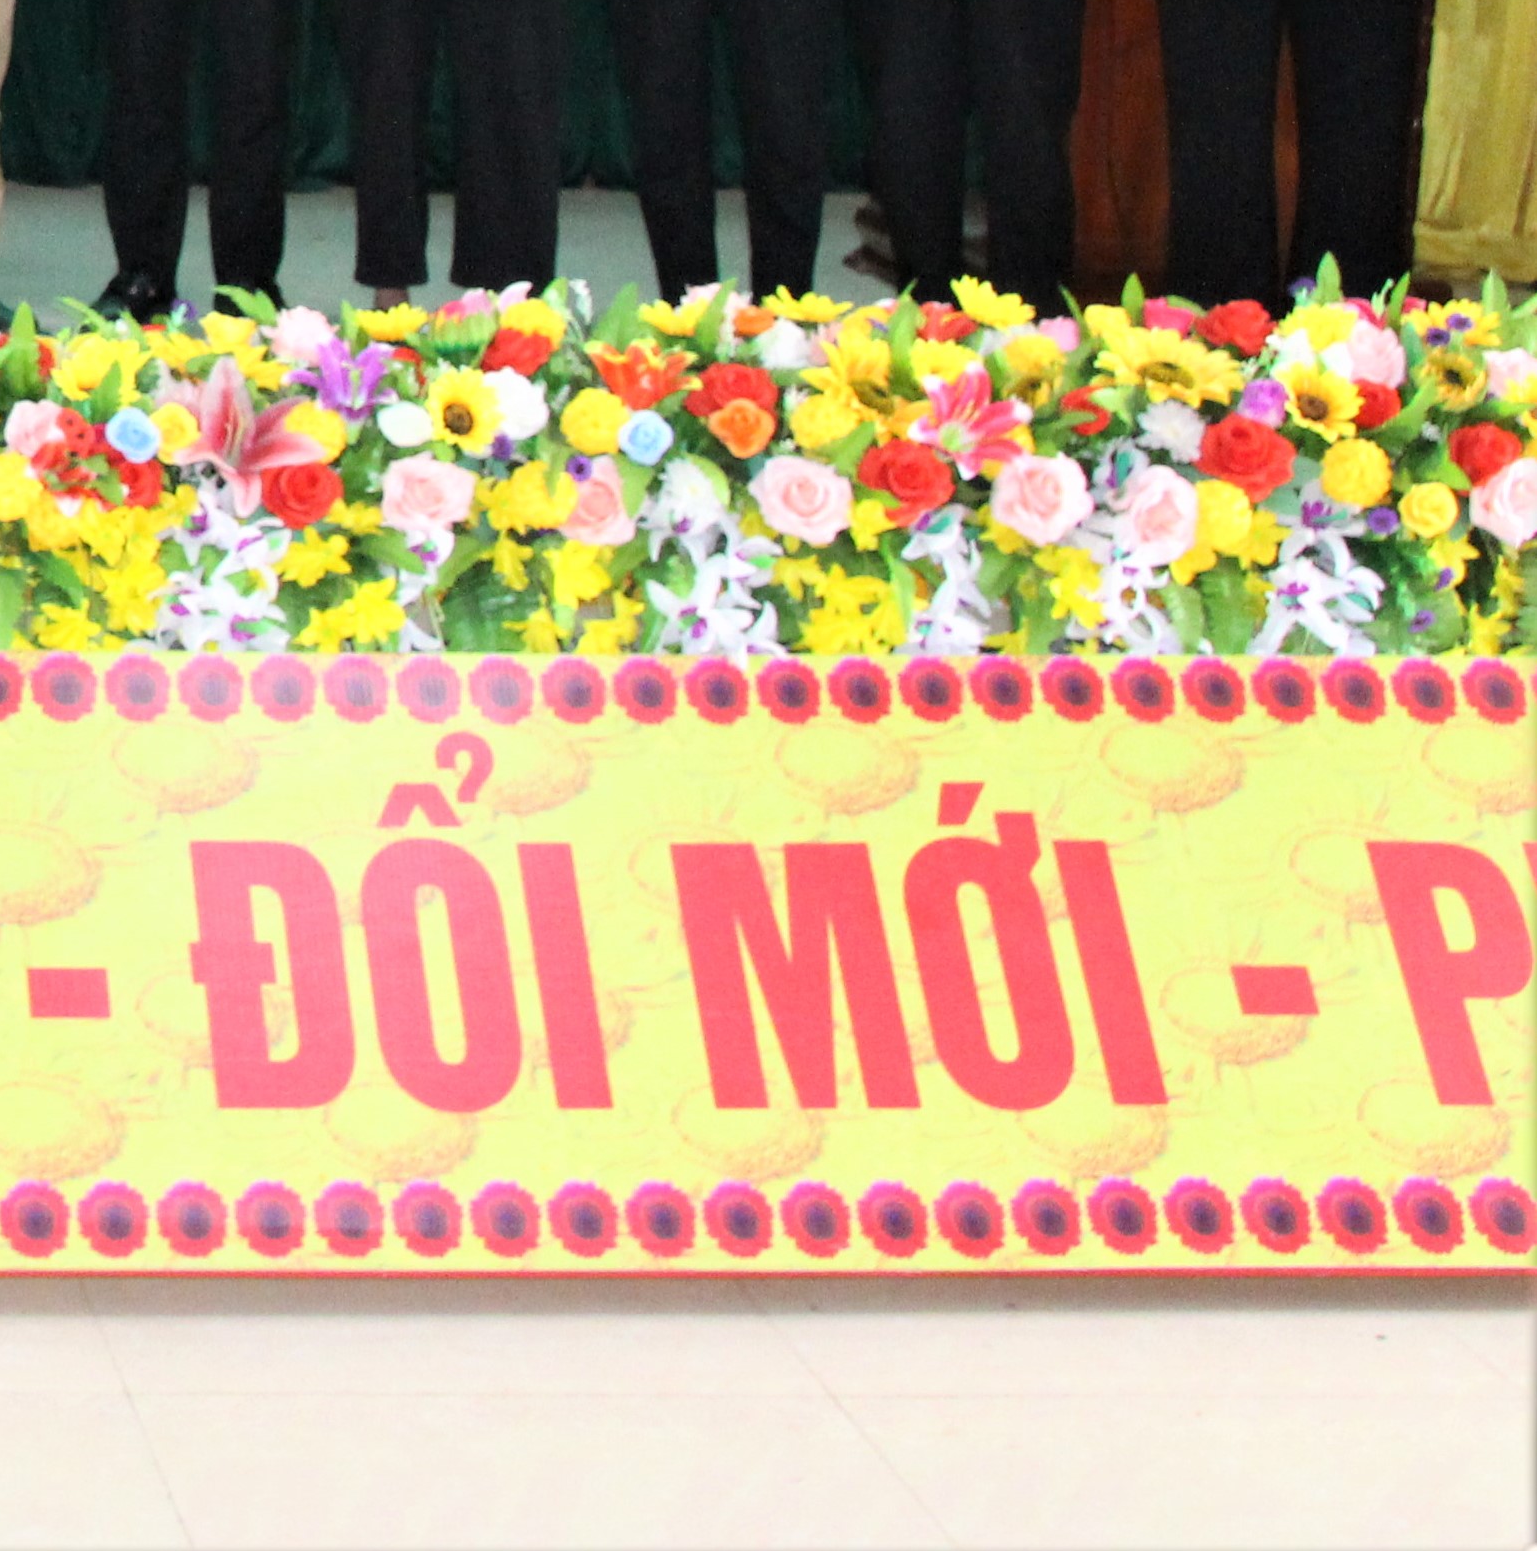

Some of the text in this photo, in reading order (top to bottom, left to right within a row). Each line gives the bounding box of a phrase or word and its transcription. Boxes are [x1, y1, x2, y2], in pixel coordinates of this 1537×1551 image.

[25, 966, 112, 1019] -
[188, 732, 615, 1113] ĐỔI
[669, 781, 1170, 1111] MỚI
[1230, 964, 1321, 1016] -
